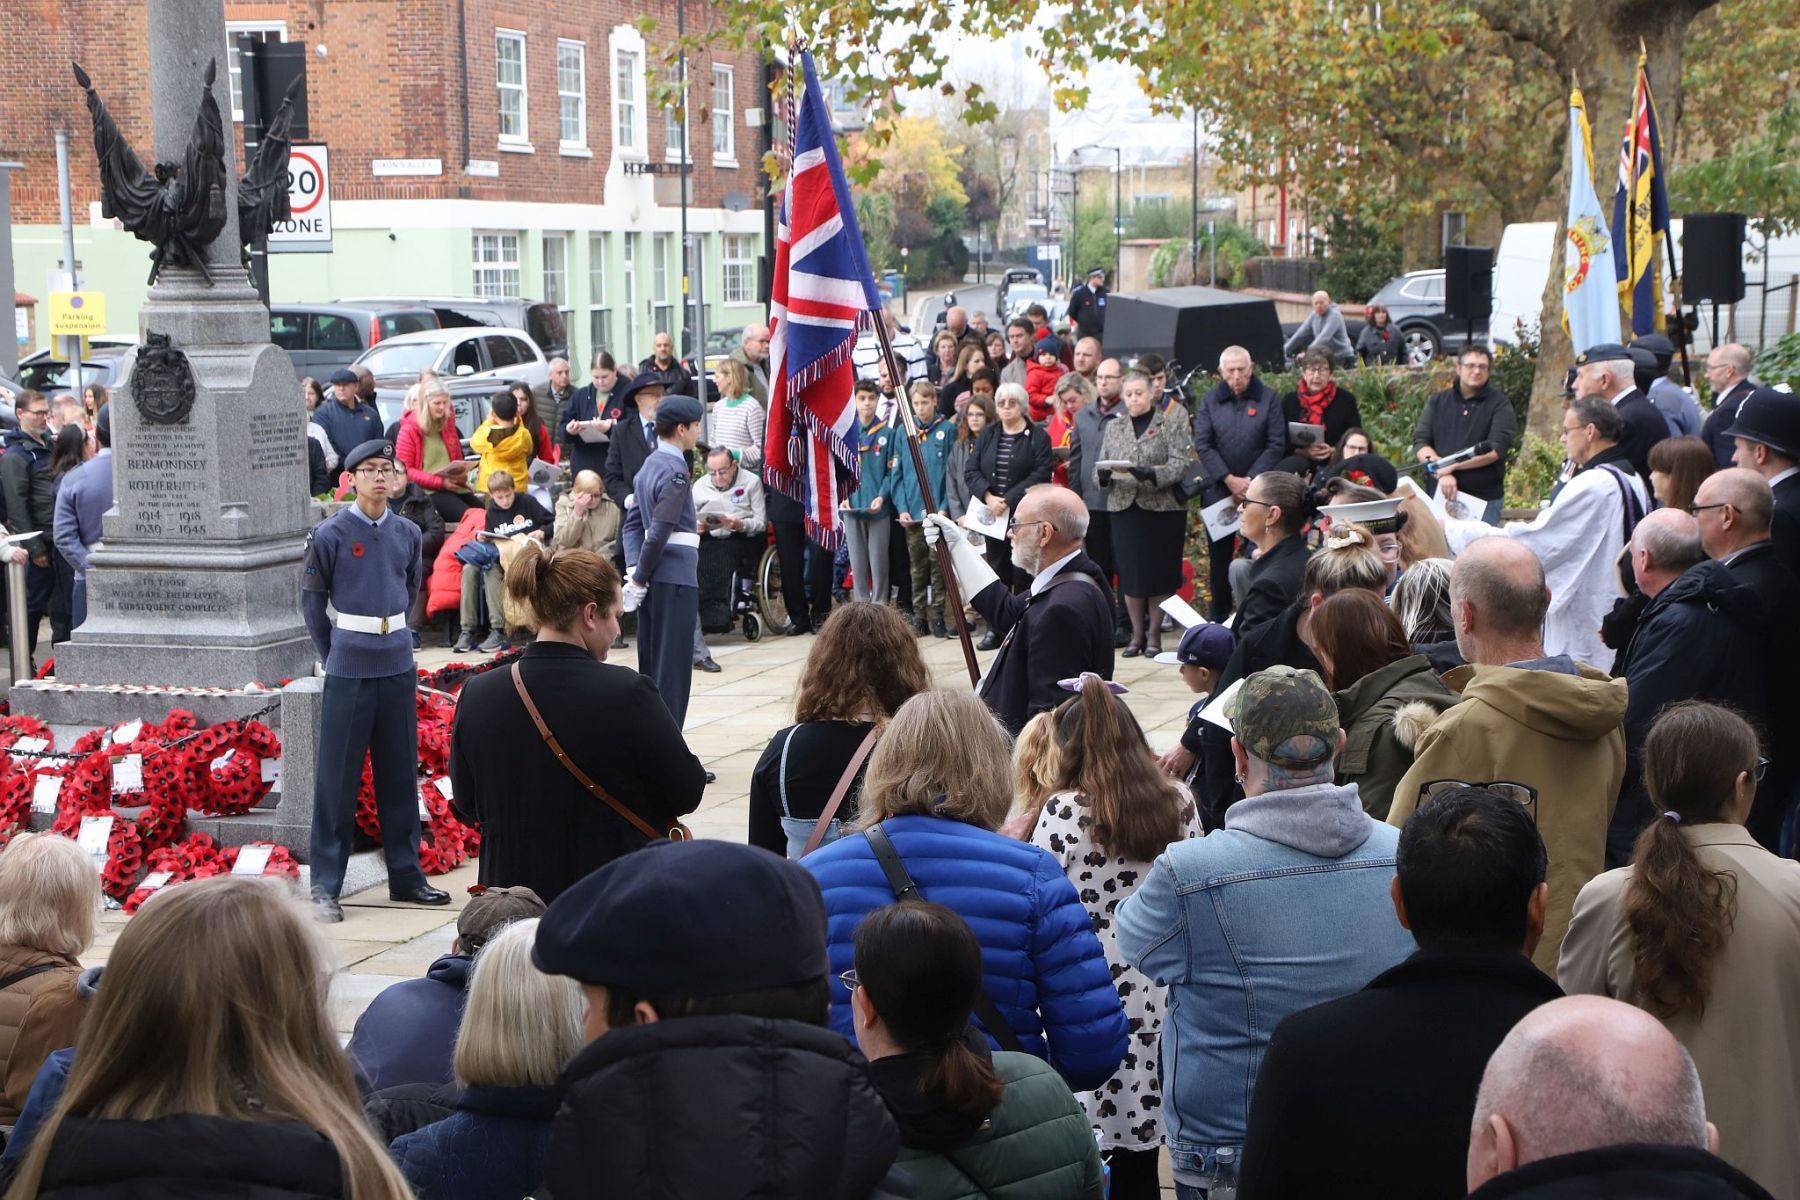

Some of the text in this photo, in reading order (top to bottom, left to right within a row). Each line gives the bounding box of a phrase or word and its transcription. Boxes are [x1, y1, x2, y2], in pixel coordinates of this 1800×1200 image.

[374, 160, 433, 169] DIXON'S ALLEY
[287, 170, 316, 194] 20
[274, 218, 323, 233] ZONE
[62, 313, 94, 321] Parking
[128, 459, 206, 470] BERMONDSEY
[129, 480, 208, 491] ROTHERHITHE
[138, 510, 162, 522] 1914
[179, 511, 201, 523] 1918
[135, 524, 162, 536] 1939
[179, 524, 206, 536] 1945
[143, 578, 186, 587] TO THOSE
[166, 591, 191, 599] THEIR
[105, 602, 228, 612] IN SUBSEQUENT CONFLICTS
